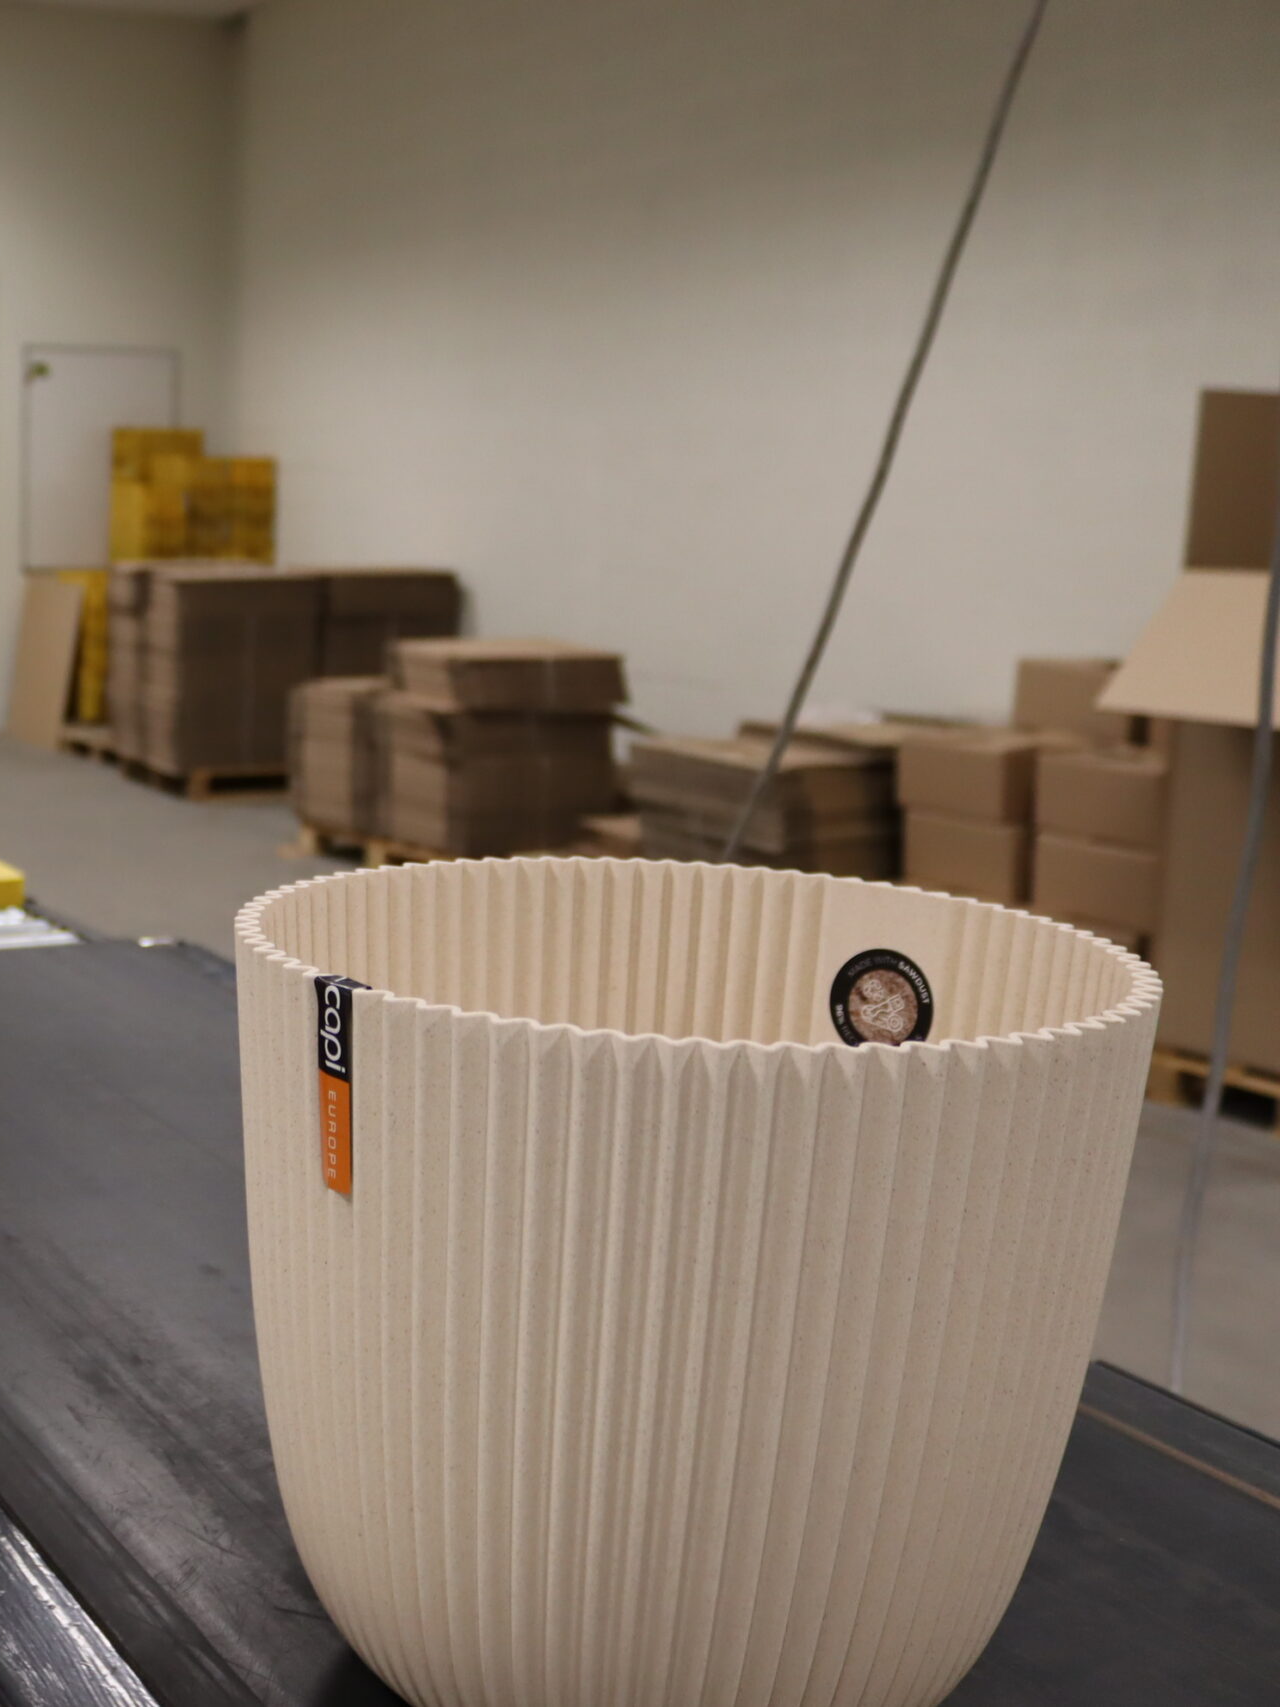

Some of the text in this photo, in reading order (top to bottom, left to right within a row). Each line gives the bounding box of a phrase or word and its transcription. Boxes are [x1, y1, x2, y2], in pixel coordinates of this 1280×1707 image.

[897, 960, 931, 1004] SAWDUST
[320, 984, 347, 1074] capi
[327, 1088, 338, 1180] EUROPE
